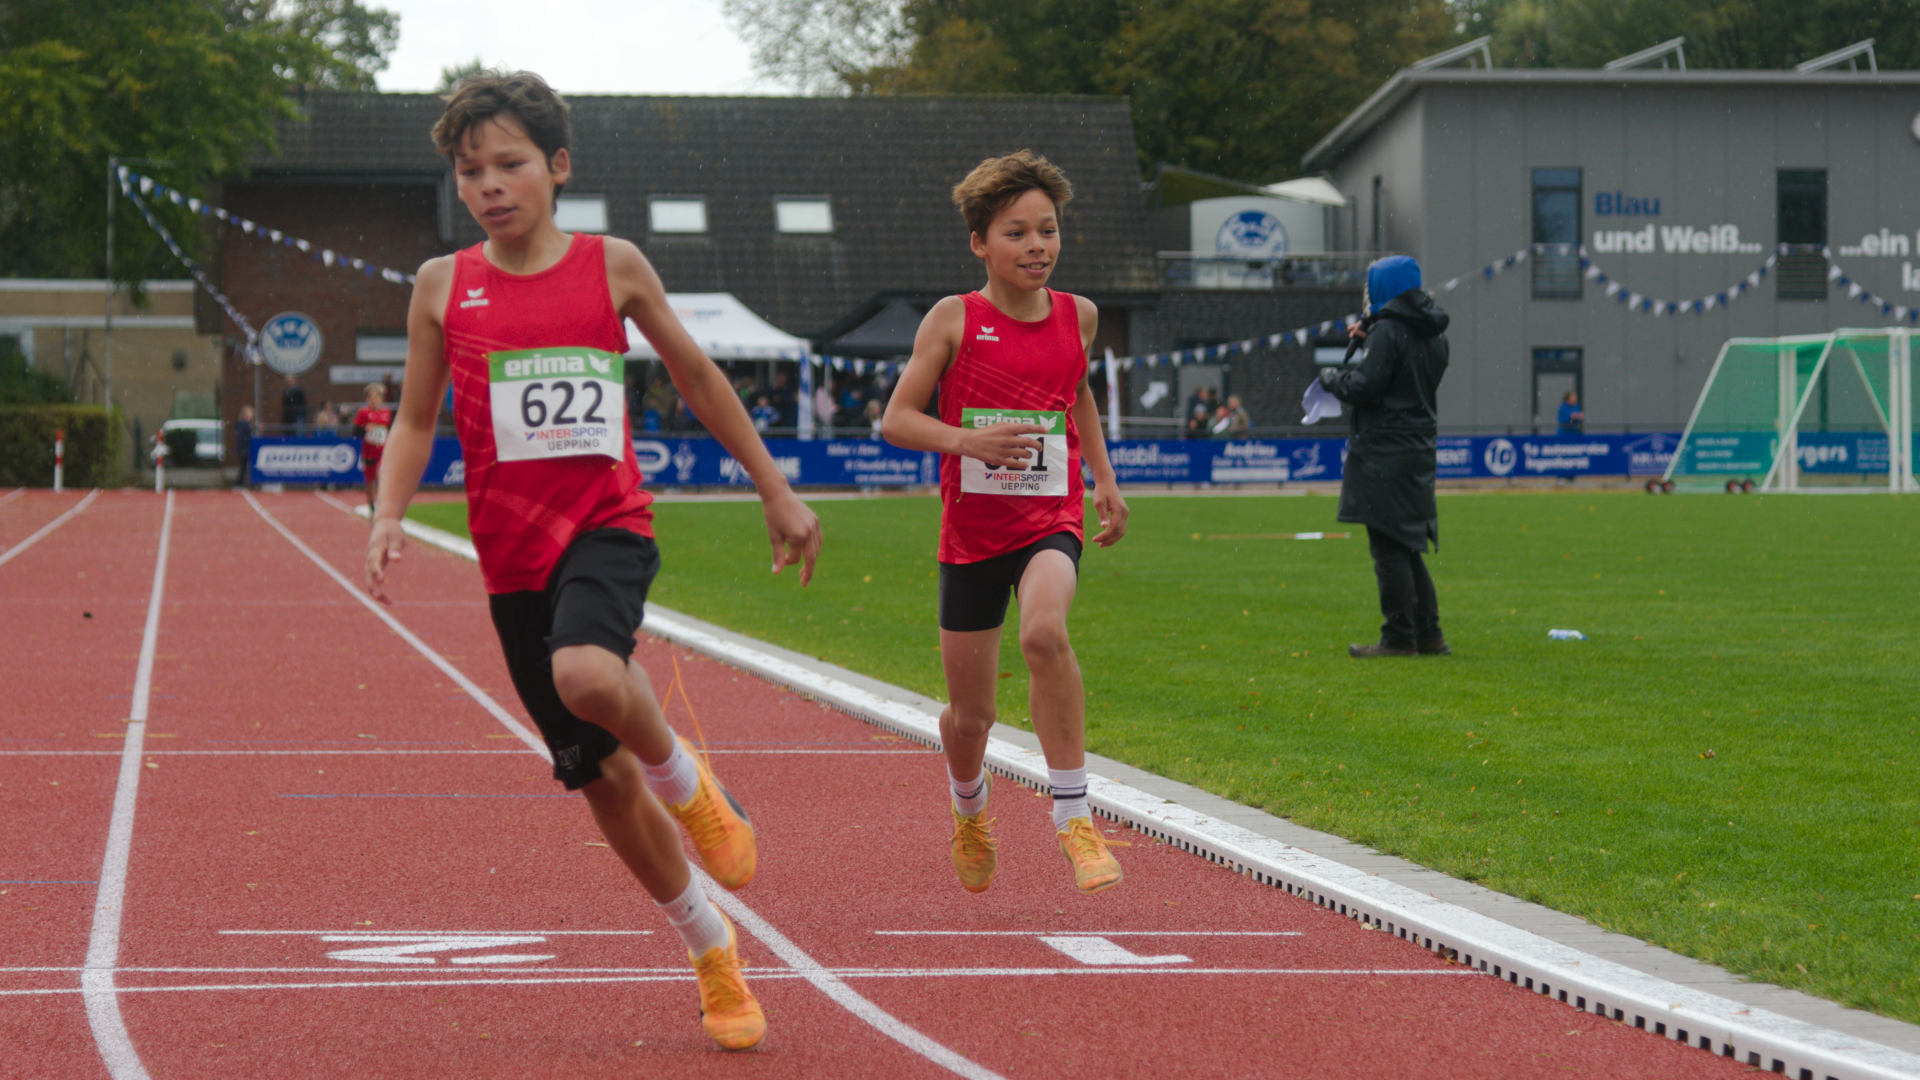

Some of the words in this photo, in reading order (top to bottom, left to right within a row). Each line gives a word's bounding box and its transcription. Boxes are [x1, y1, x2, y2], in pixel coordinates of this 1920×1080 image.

[1595, 191, 1661, 215] Blau
[1593, 223, 1655, 253] und
[1661, 224, 1763, 253] Weiß...
[1839, 227, 1909, 257] ...ein
[504, 354, 586, 377] erima
[521, 380, 606, 427] 622
[536, 427, 608, 441] INTERSPORT
[547, 438, 600, 451] UEPPING
[993, 473, 1048, 482] INTERSPORT
[1001, 482, 1040, 491] UEPPING
